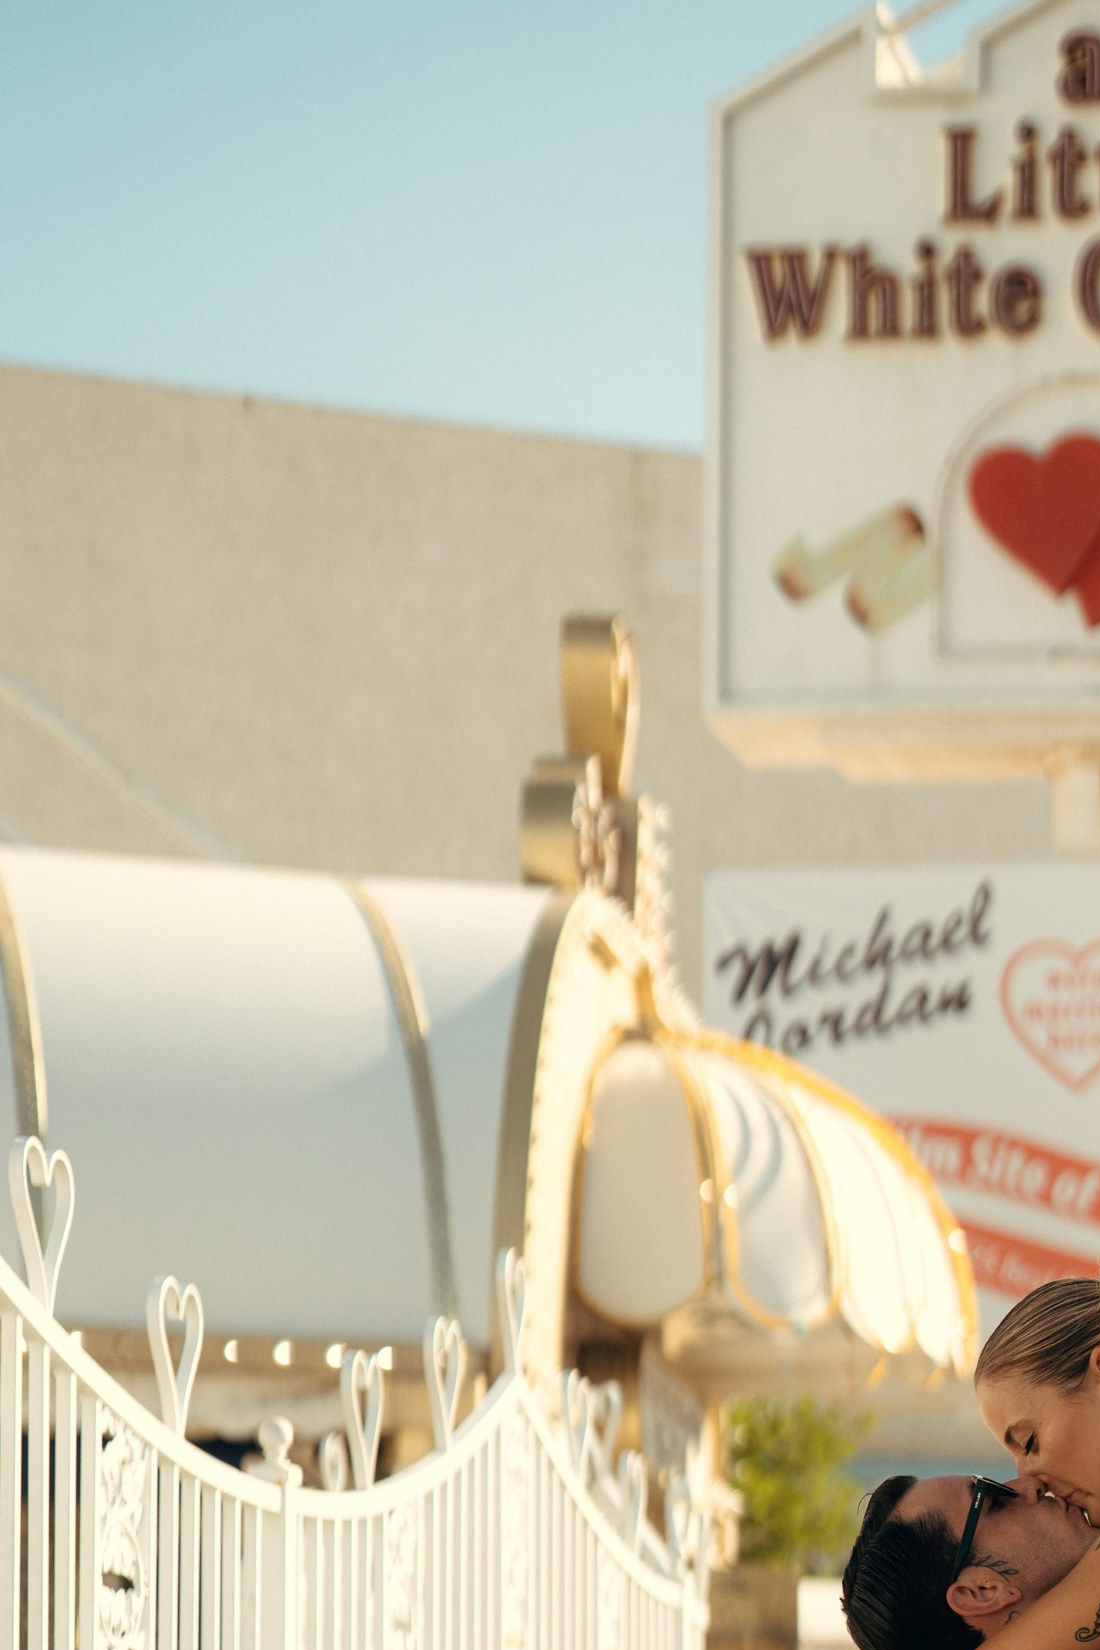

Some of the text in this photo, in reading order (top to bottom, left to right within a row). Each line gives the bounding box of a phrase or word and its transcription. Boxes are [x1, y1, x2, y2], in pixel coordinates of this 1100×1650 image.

[745, 236, 1044, 343] White
[715, 882, 993, 1005] Michael
[968, 1128, 1049, 1200] Site
